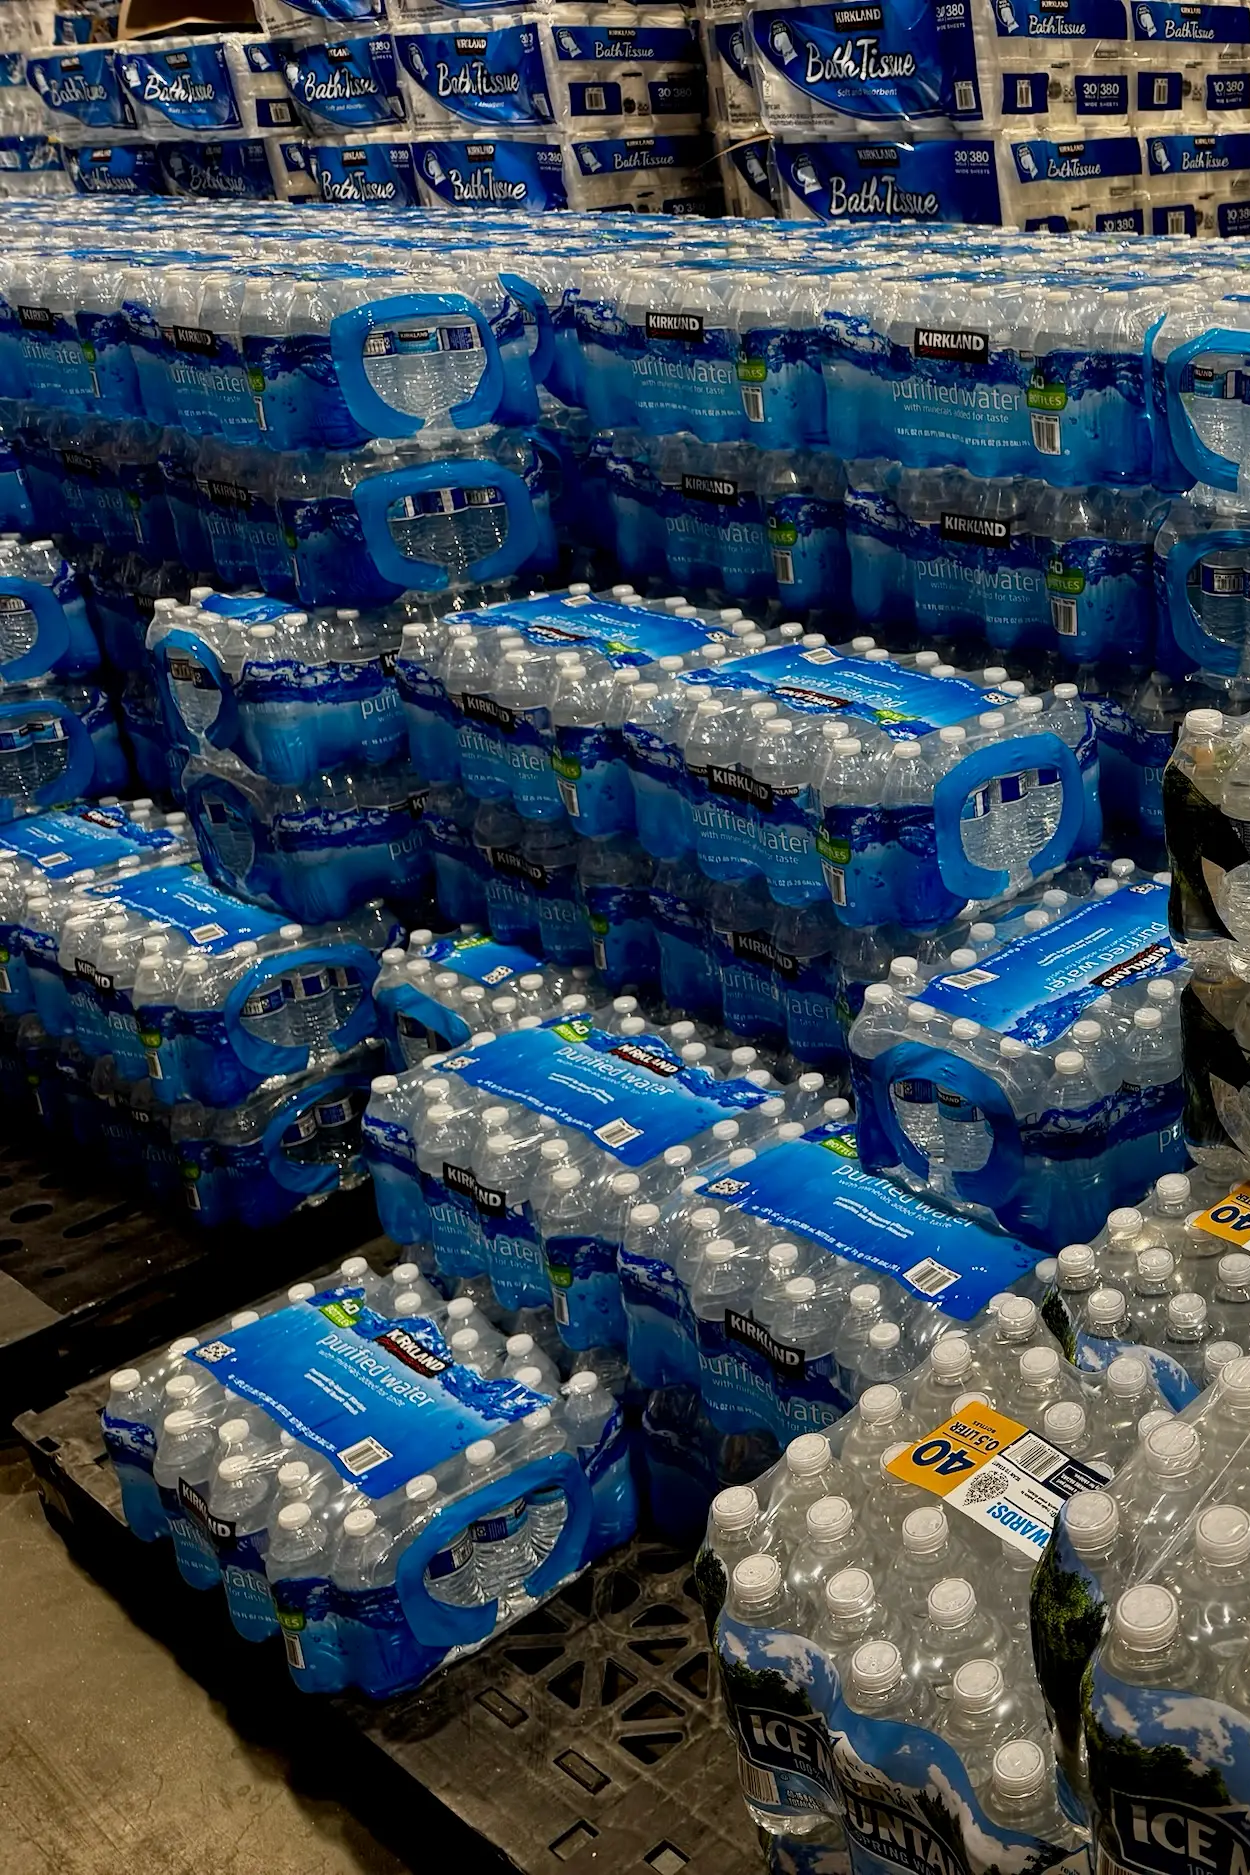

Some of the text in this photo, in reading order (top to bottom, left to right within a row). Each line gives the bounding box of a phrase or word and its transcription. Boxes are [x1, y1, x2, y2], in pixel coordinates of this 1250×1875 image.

[835, 8, 882, 25] KIRKLAND
[623, 41, 655, 58] Tissue
[805, 38, 916, 84] Bath Tissue
[1083, 83, 1119, 96] 30 380
[613, 153, 674, 170] Bath Tissue
[1182, 153, 1208, 170] Bath
[355, 168, 396, 200] Tissue
[829, 174, 939, 216] Bath Tissue
[919, 331, 985, 351] KIRKLAND
[684, 362, 733, 384] water
[1030, 374, 1045, 390] 40
[892, 378, 1020, 412] purified water
[1029, 393, 1063, 407] BOTTLES
[945, 515, 1007, 538] KIRKLAND
[916, 558, 1041, 593] purified water
[1049, 560, 1063, 575] 40
[1099, 920, 1168, 963] purified
[1043, 960, 1101, 994] water
[1101, 946, 1171, 988] KIRKLAND
[553, 1046, 626, 1077] purified
[622, 1072, 675, 1096] water
[618, 1043, 679, 1075] KIRKLAND
[448, 1167, 502, 1208] KIRKND
[831, 1164, 915, 1204] purified
[858, 1184, 915, 1217] minerals added
[343, 1298, 360, 1315] 40
[386, 1328, 446, 1373] KIRKLAND
[315, 1332, 393, 1377] purified
[379, 1368, 435, 1410] water
[699, 1351, 774, 1401] purified
[712, 1378, 734, 1389] with
[949, 1420, 1000, 1451] LITER 0.5
[911, 1436, 977, 1476] 40
[986, 1501, 1050, 1549] WARDS!
[750, 1714, 812, 1761] ICE
[853, 1831, 909, 1866] SPRING
[1131, 1803, 1218, 1870] ICE
